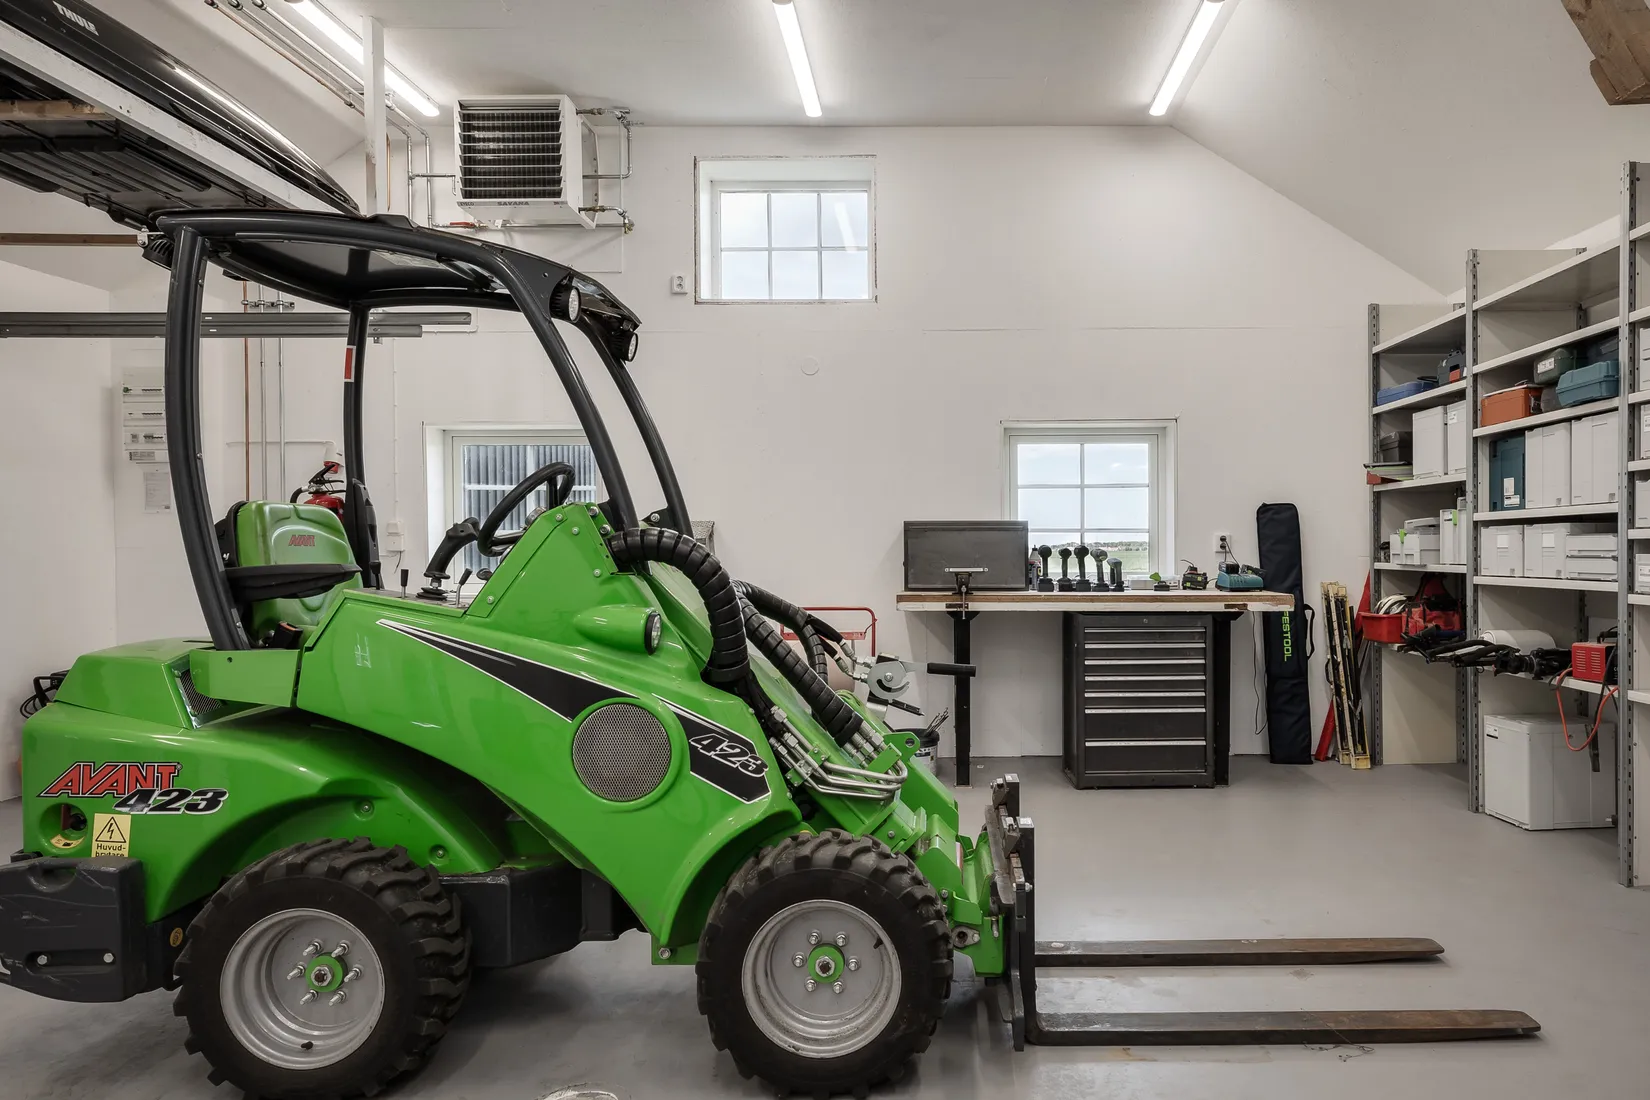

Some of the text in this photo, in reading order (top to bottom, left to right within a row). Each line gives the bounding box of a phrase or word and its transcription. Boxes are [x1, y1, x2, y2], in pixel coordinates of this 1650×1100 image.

[52, 0, 99, 36] THULE
[689, 733, 769, 778] 423
[37, 762, 181, 798] AVANT
[113, 788, 229, 815] 423
[96, 843, 126, 851] Huvud-
